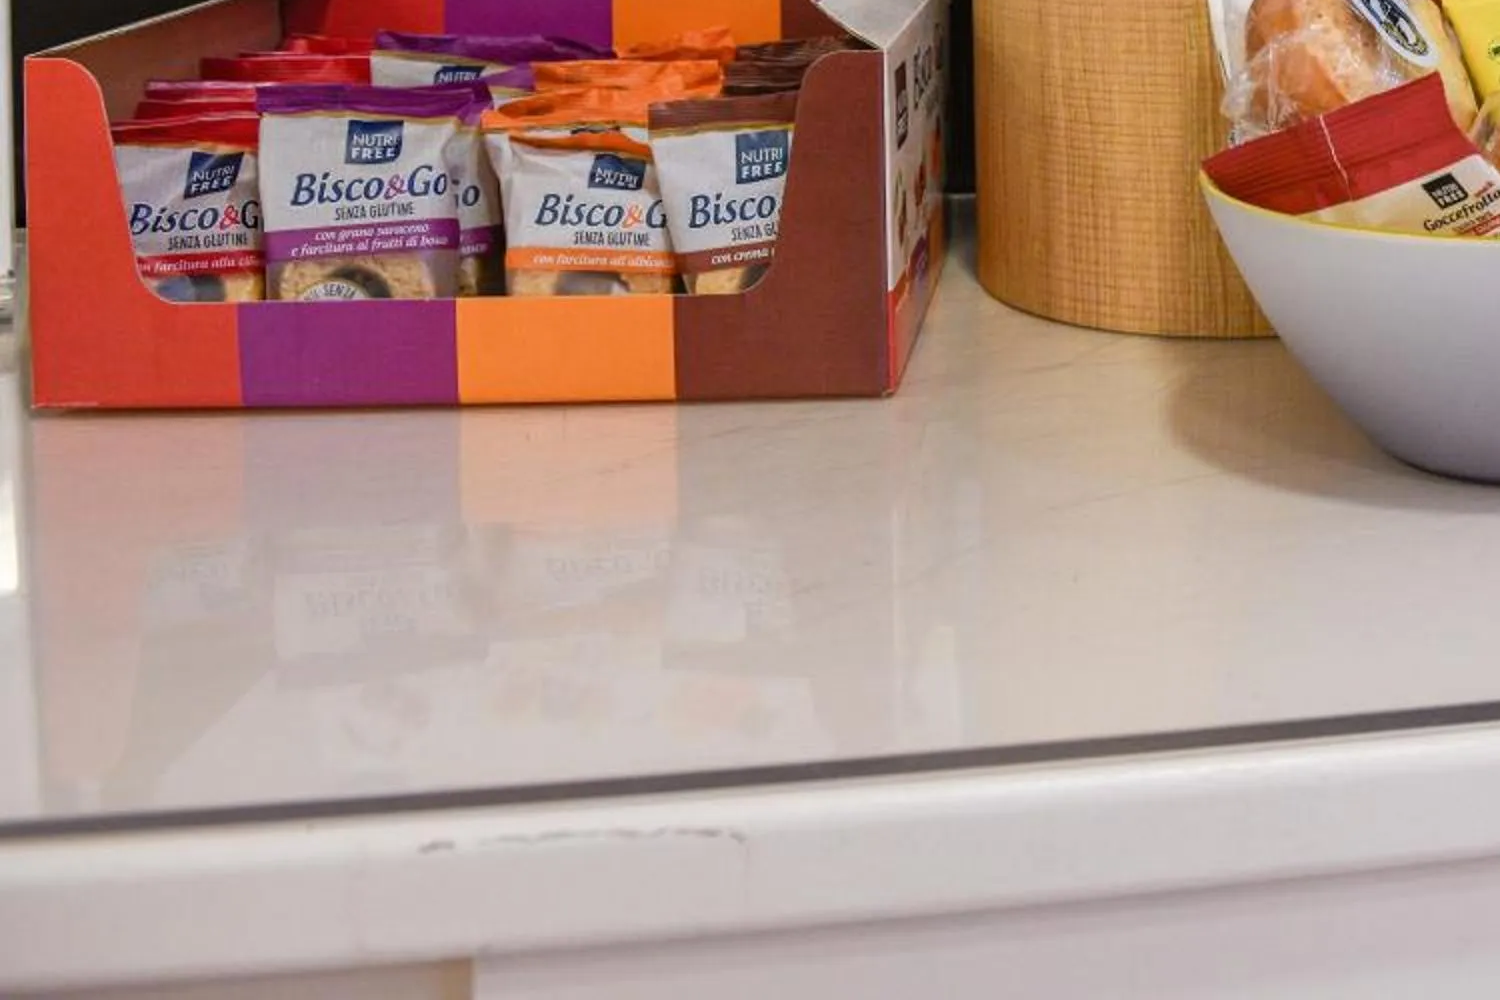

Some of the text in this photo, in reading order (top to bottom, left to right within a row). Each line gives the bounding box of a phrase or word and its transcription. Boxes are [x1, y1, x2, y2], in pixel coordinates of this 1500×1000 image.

[352, 133, 399, 147] NUTRI
[351, 147, 396, 159] FREE
[741, 147, 783, 164] NUTRI
[192, 165, 235, 181] NUTRI
[741, 161, 783, 179] FREE
[190, 176, 231, 193] FREE
[130, 200, 259, 235] Bisco&G
[334, 202, 415, 221] SENZA GLUTINE
[534, 193, 667, 229] Bisco&G
[688, 192, 777, 228] Bisco
[168, 233, 247, 251] SENZA GLUTINE
[315, 230, 336, 241] con
[338, 227, 375, 240] grano
[574, 231, 651, 246] SENZA GLUTINE
[291, 247, 299, 257] e
[300, 243, 353, 257] farcitura
[371, 237, 403, 251] frutti
